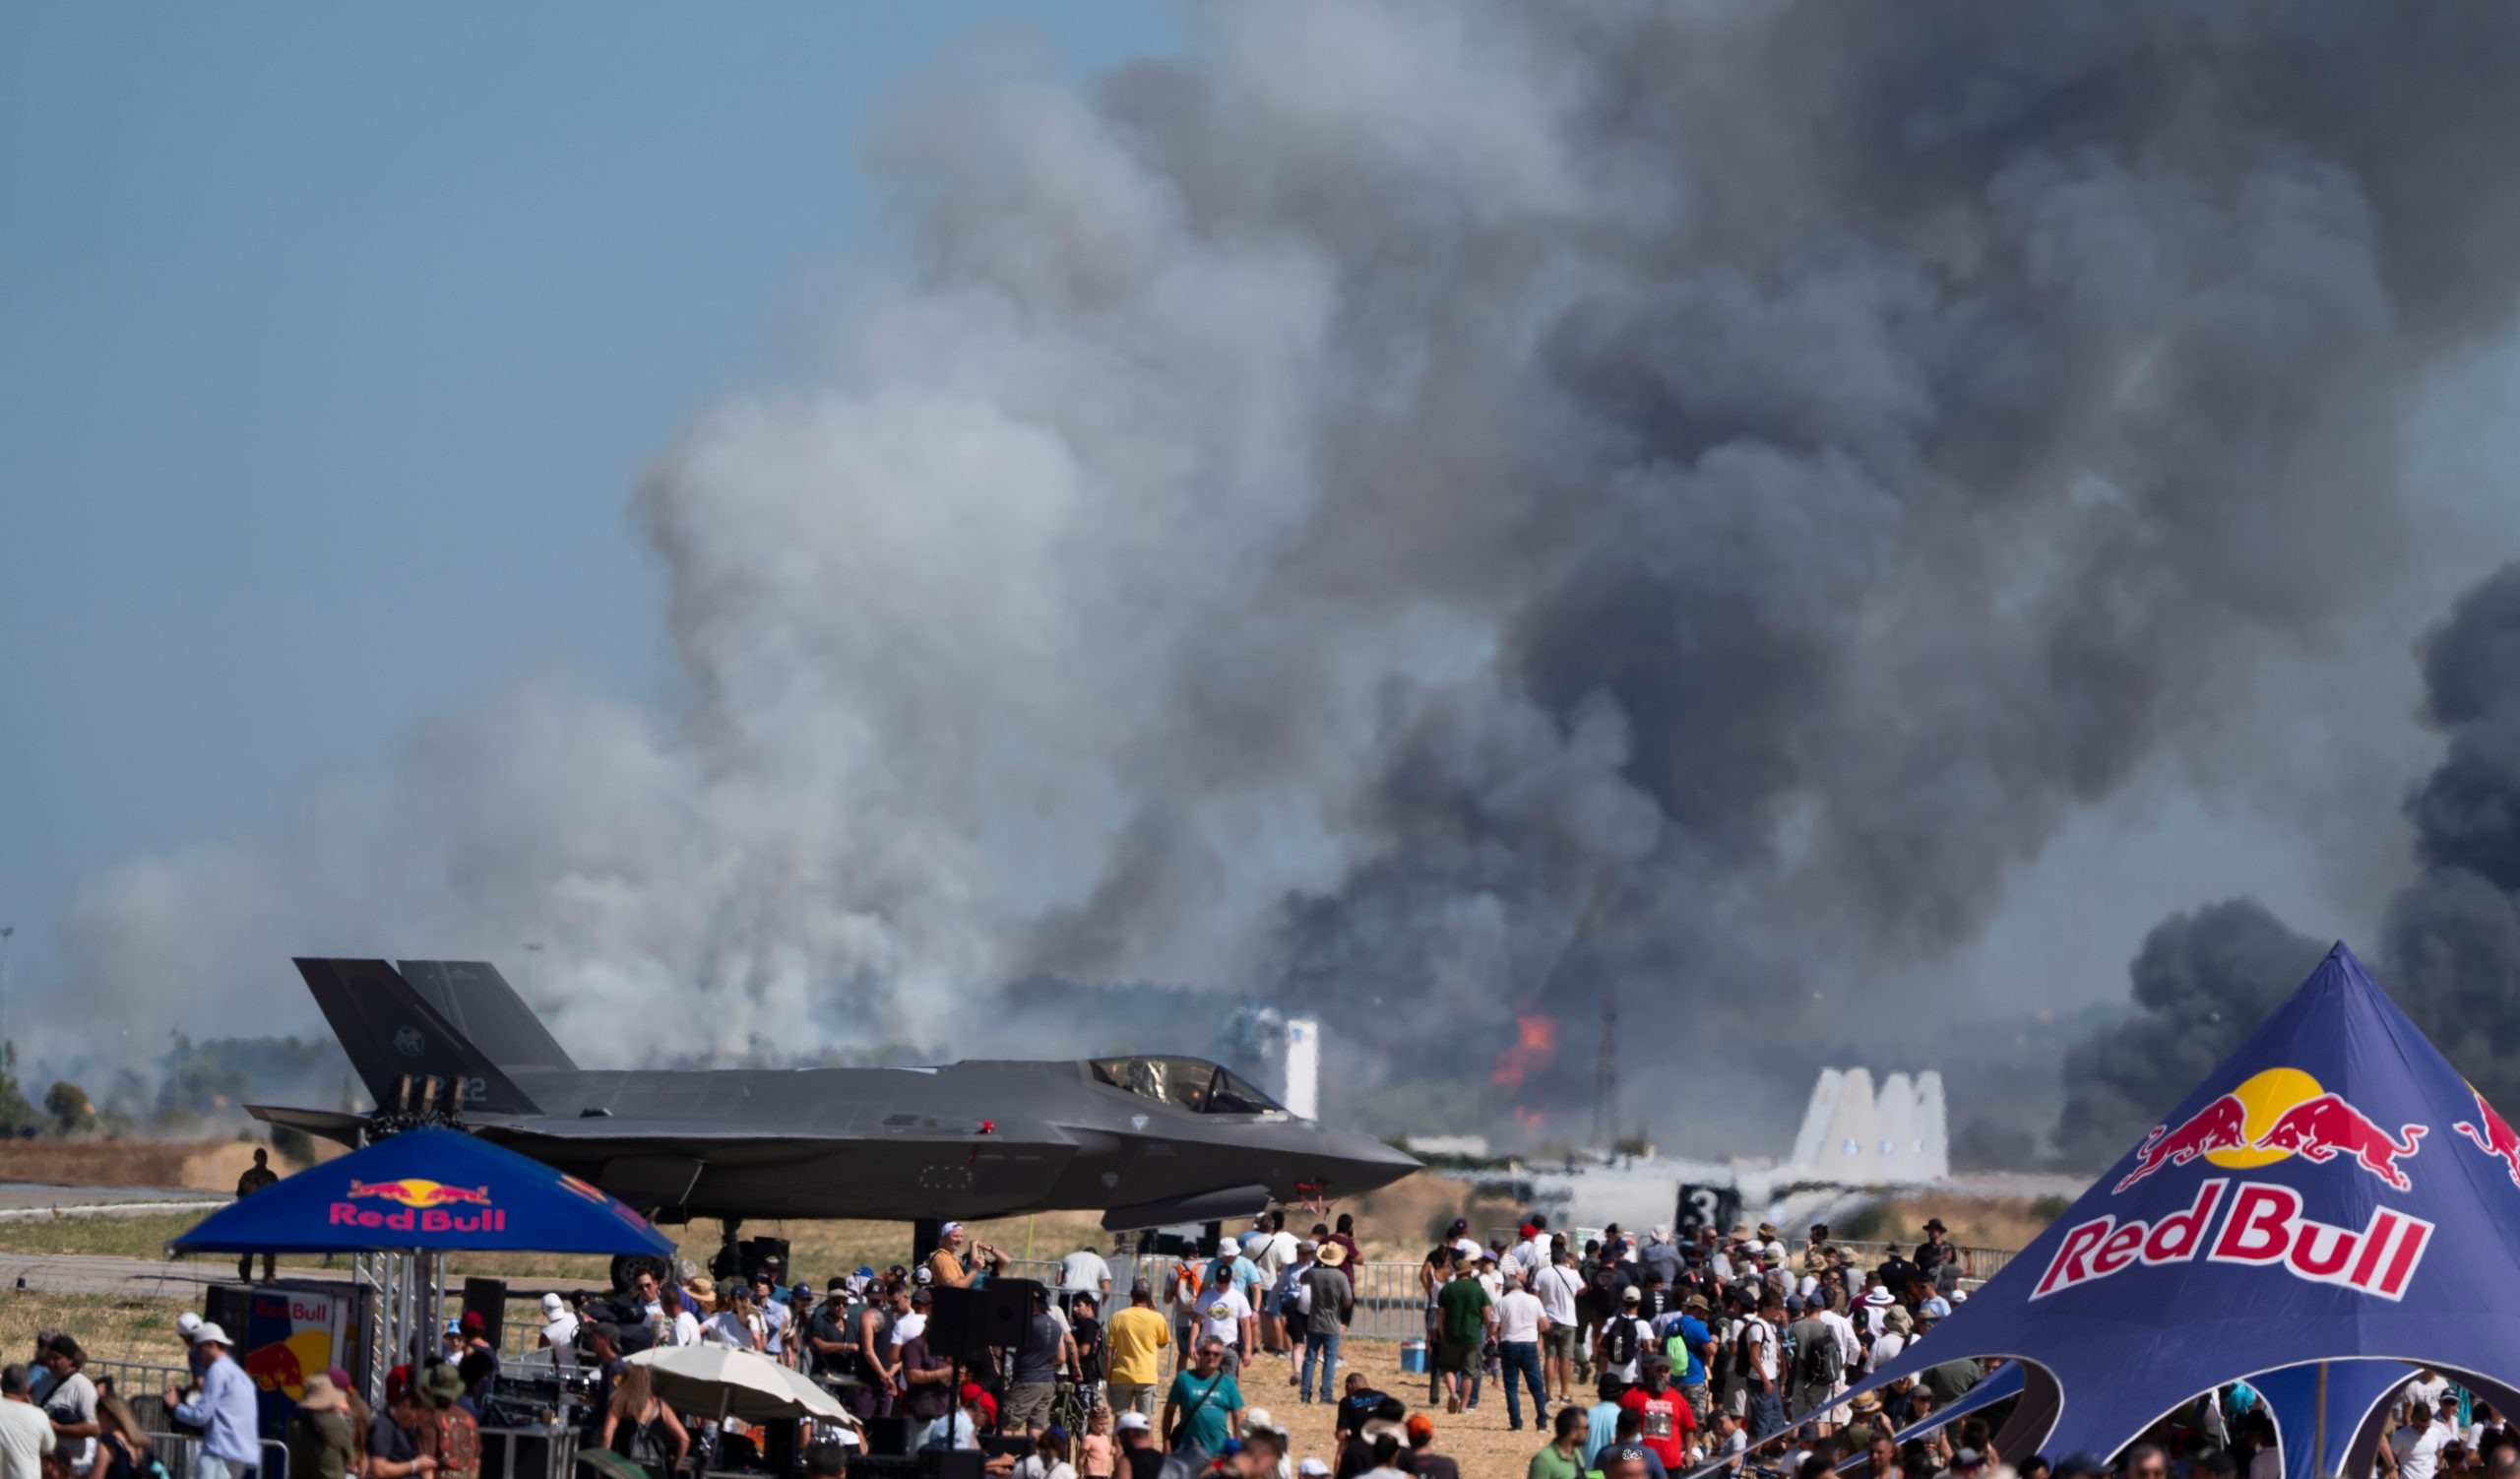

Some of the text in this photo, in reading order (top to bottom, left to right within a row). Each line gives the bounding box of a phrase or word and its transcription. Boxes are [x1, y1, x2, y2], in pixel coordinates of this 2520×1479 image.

[329, 1201, 506, 1232] Red Bull
[2032, 1179, 2432, 1300] Red Bull
[292, 1303, 327, 1322] Bull
